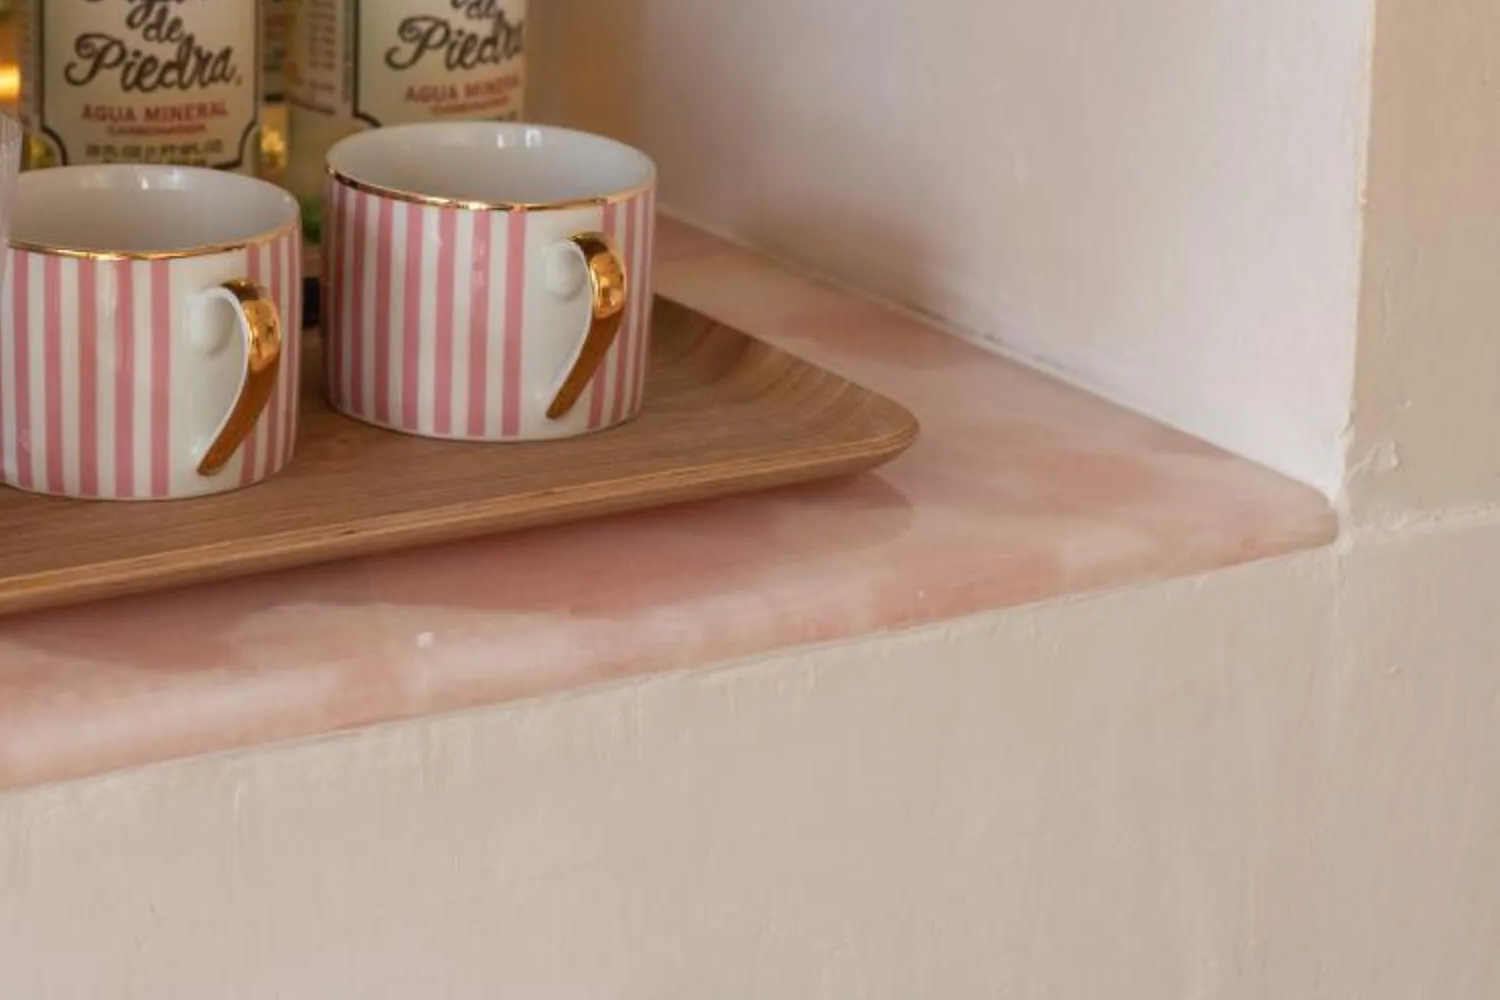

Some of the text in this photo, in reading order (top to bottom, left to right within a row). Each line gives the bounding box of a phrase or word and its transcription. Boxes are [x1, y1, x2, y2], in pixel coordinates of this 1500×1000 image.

[143, 6, 184, 44] de
[82, 99, 229, 123] AGUA MINERAL
